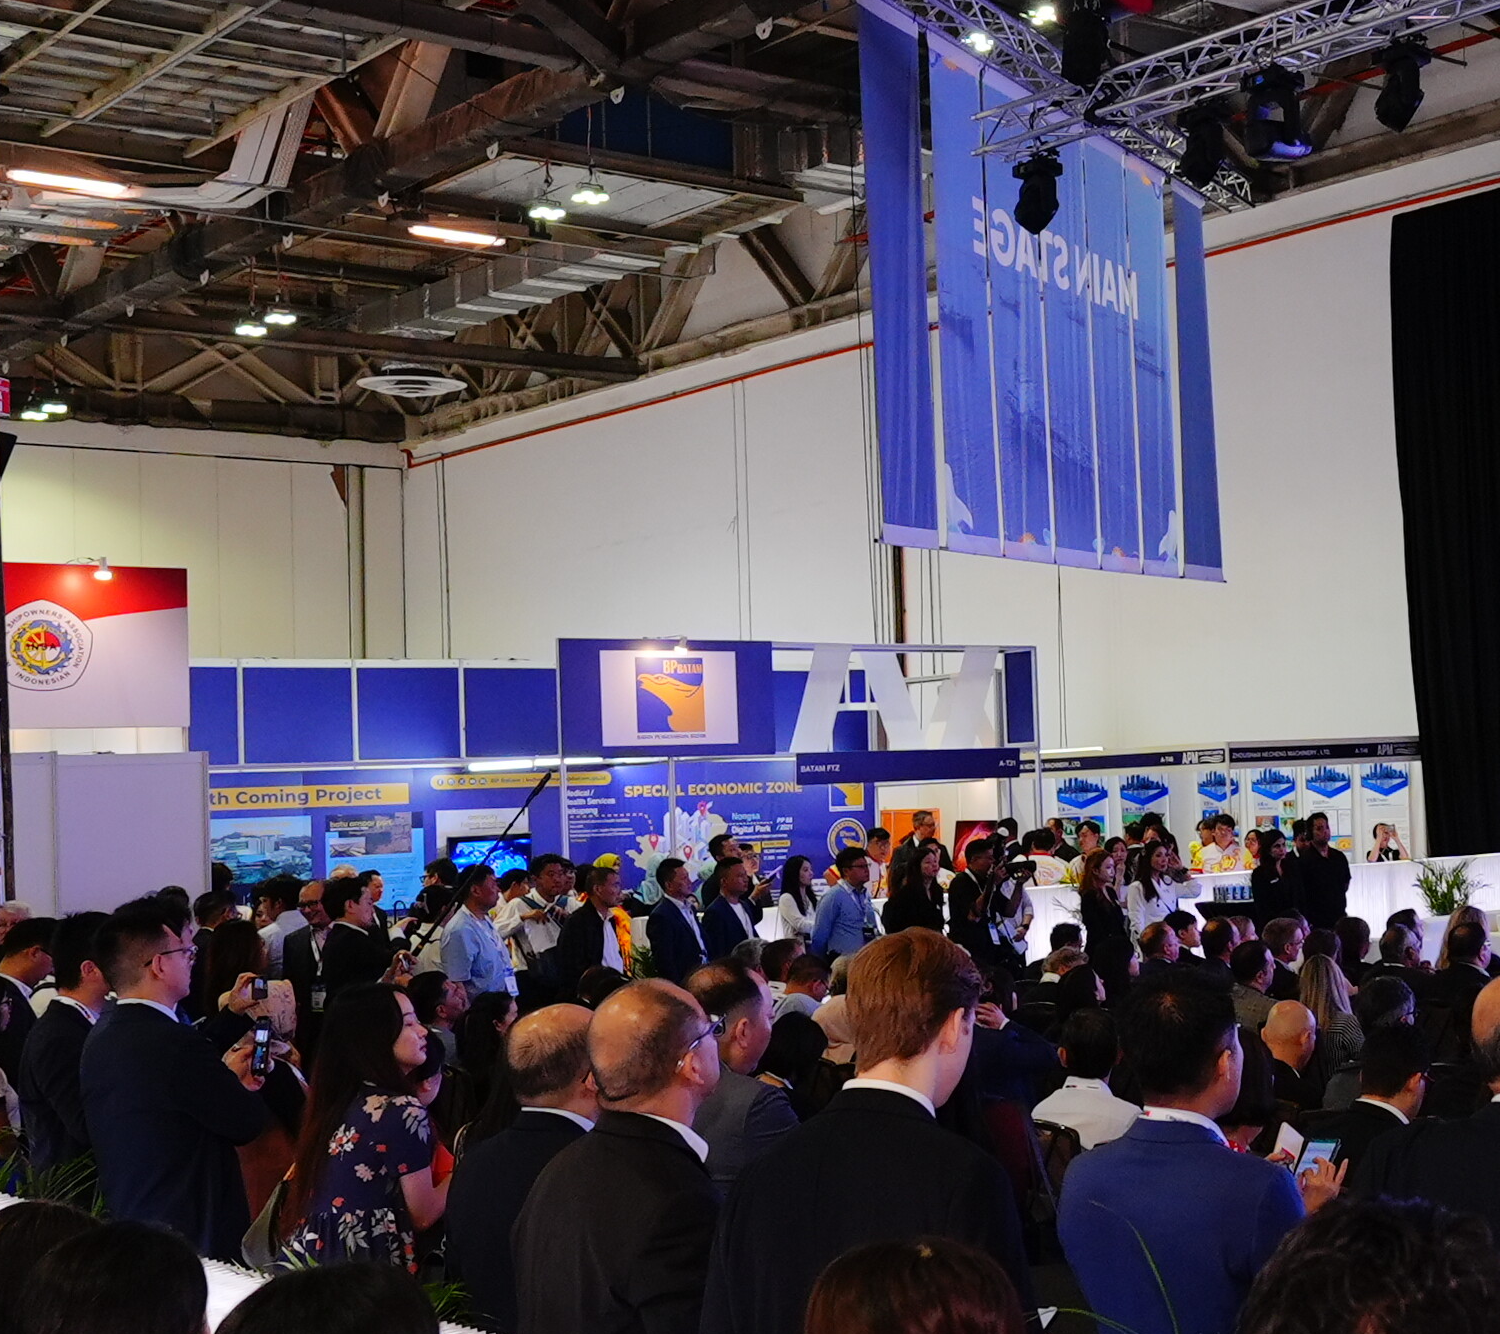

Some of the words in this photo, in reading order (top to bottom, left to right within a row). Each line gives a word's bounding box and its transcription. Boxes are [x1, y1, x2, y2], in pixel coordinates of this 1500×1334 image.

[15, 671, 71, 685] INDONESIAN
[1376, 744, 1394, 756] APM
[1181, 751, 1199, 765] APM
[800, 765, 826, 773] BATAM
[688, 782, 763, 796] ECONOMIC
[766, 780, 803, 794] ZONE
[236, 788, 310, 806] Coming
[316, 786, 382, 803] Project
